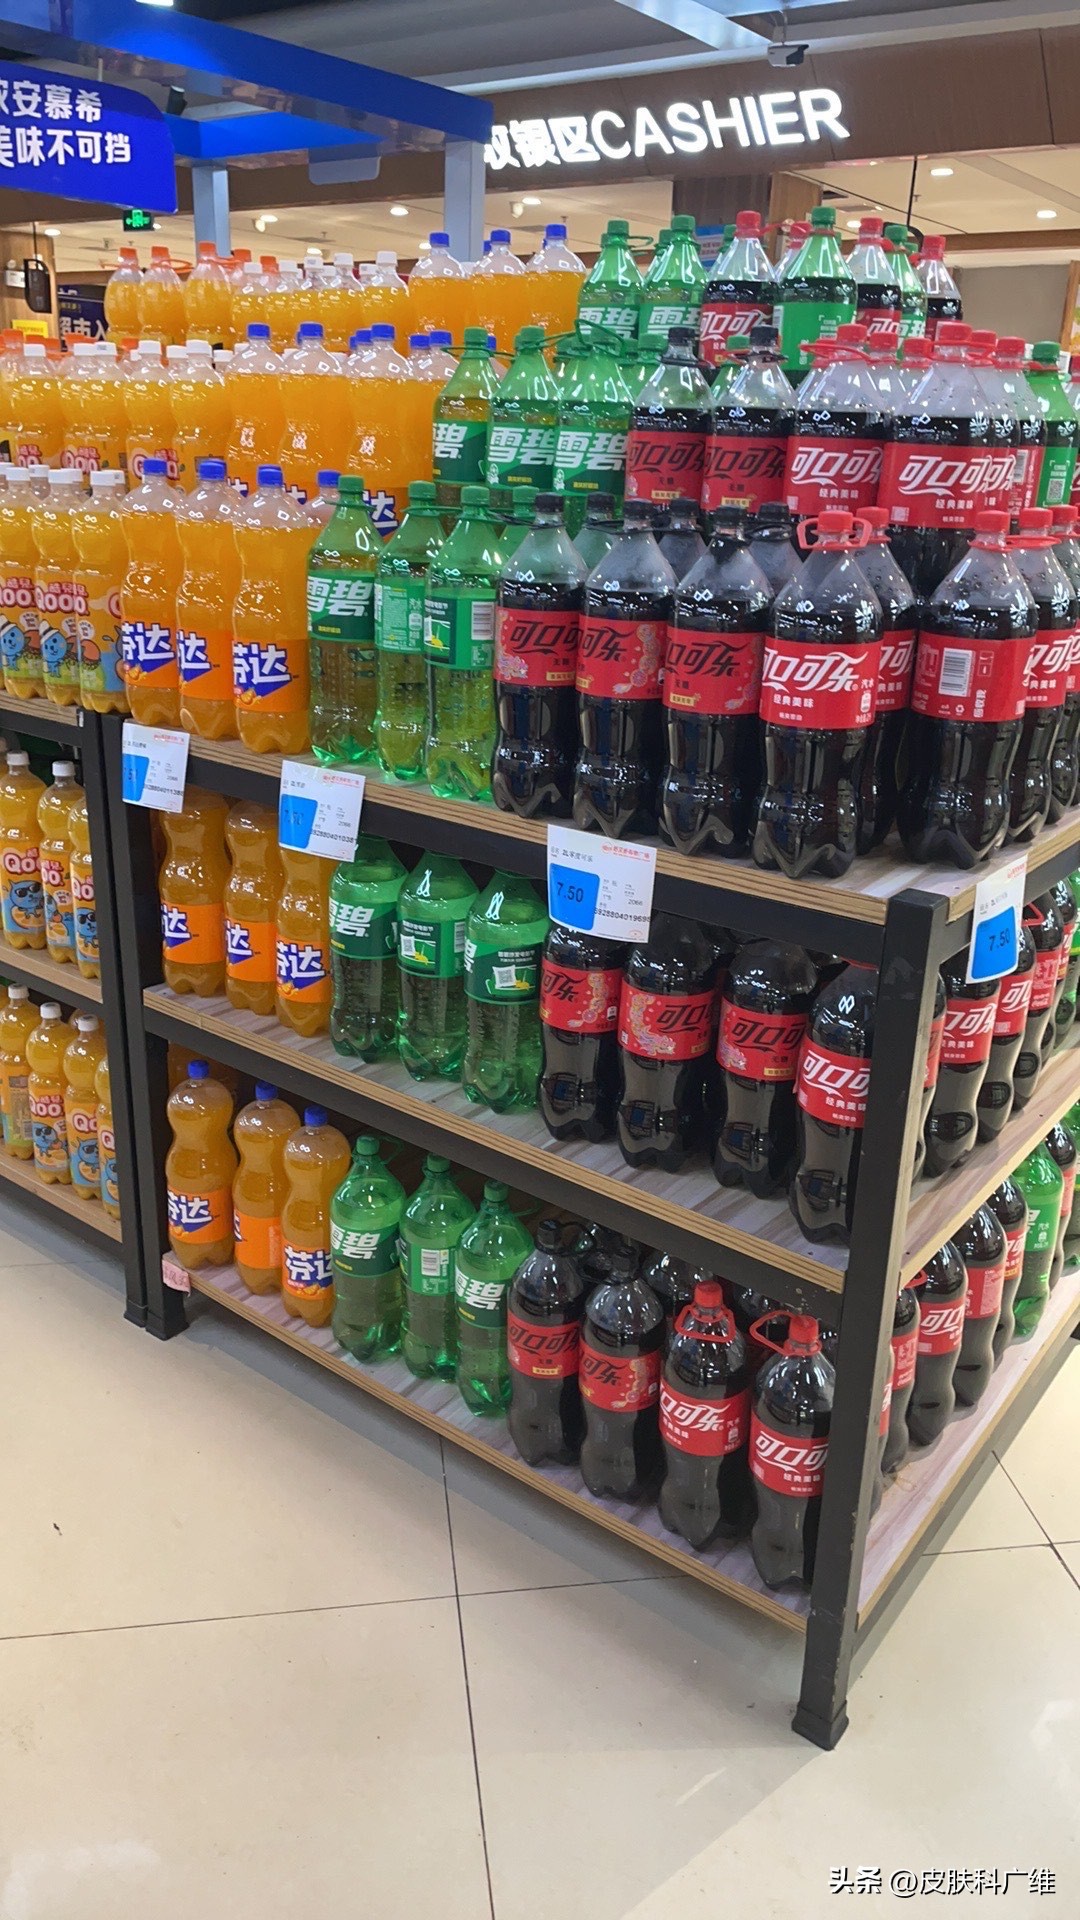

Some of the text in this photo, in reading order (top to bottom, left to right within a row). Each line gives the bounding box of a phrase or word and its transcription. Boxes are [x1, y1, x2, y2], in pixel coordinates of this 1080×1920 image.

[488, 426, 554, 466] 雪碧
[554, 430, 628, 472] 雪碧
[556, 881, 584, 903] 7.50
[226, 920, 253, 956] 达
[660, 1390, 731, 1432] 口可乐
